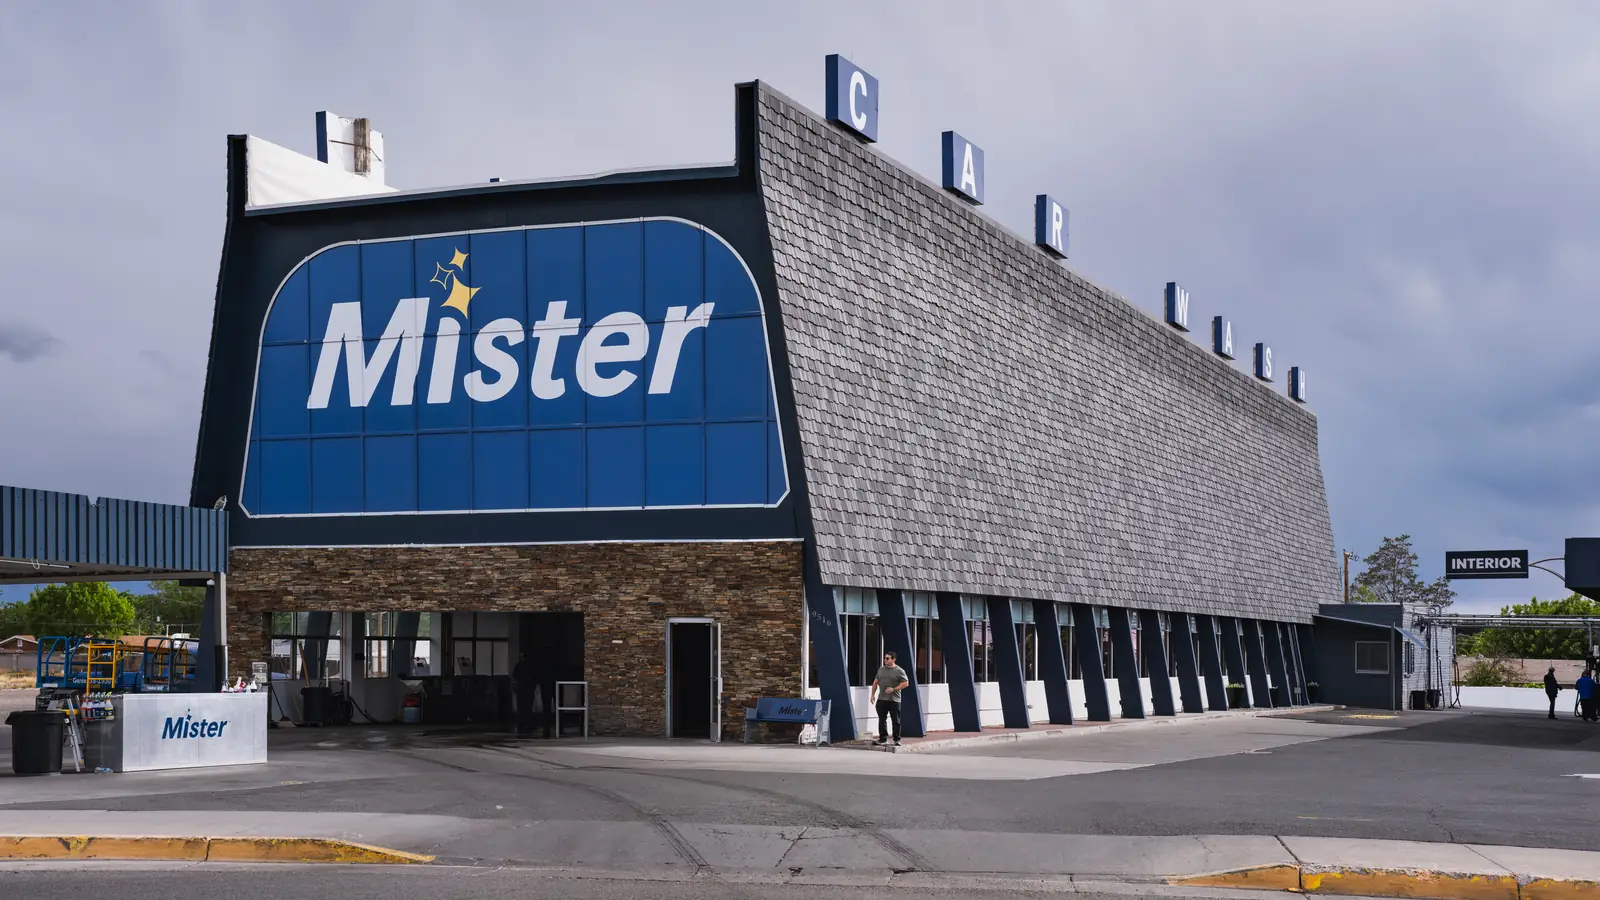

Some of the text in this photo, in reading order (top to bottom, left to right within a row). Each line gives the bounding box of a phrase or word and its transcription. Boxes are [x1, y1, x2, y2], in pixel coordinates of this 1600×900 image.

[306, 275, 715, 409] Mister
[1451, 557, 1522, 570] INTERIOR
[811, 610, 832, 627] 9516
[162, 713, 228, 739] Mister
